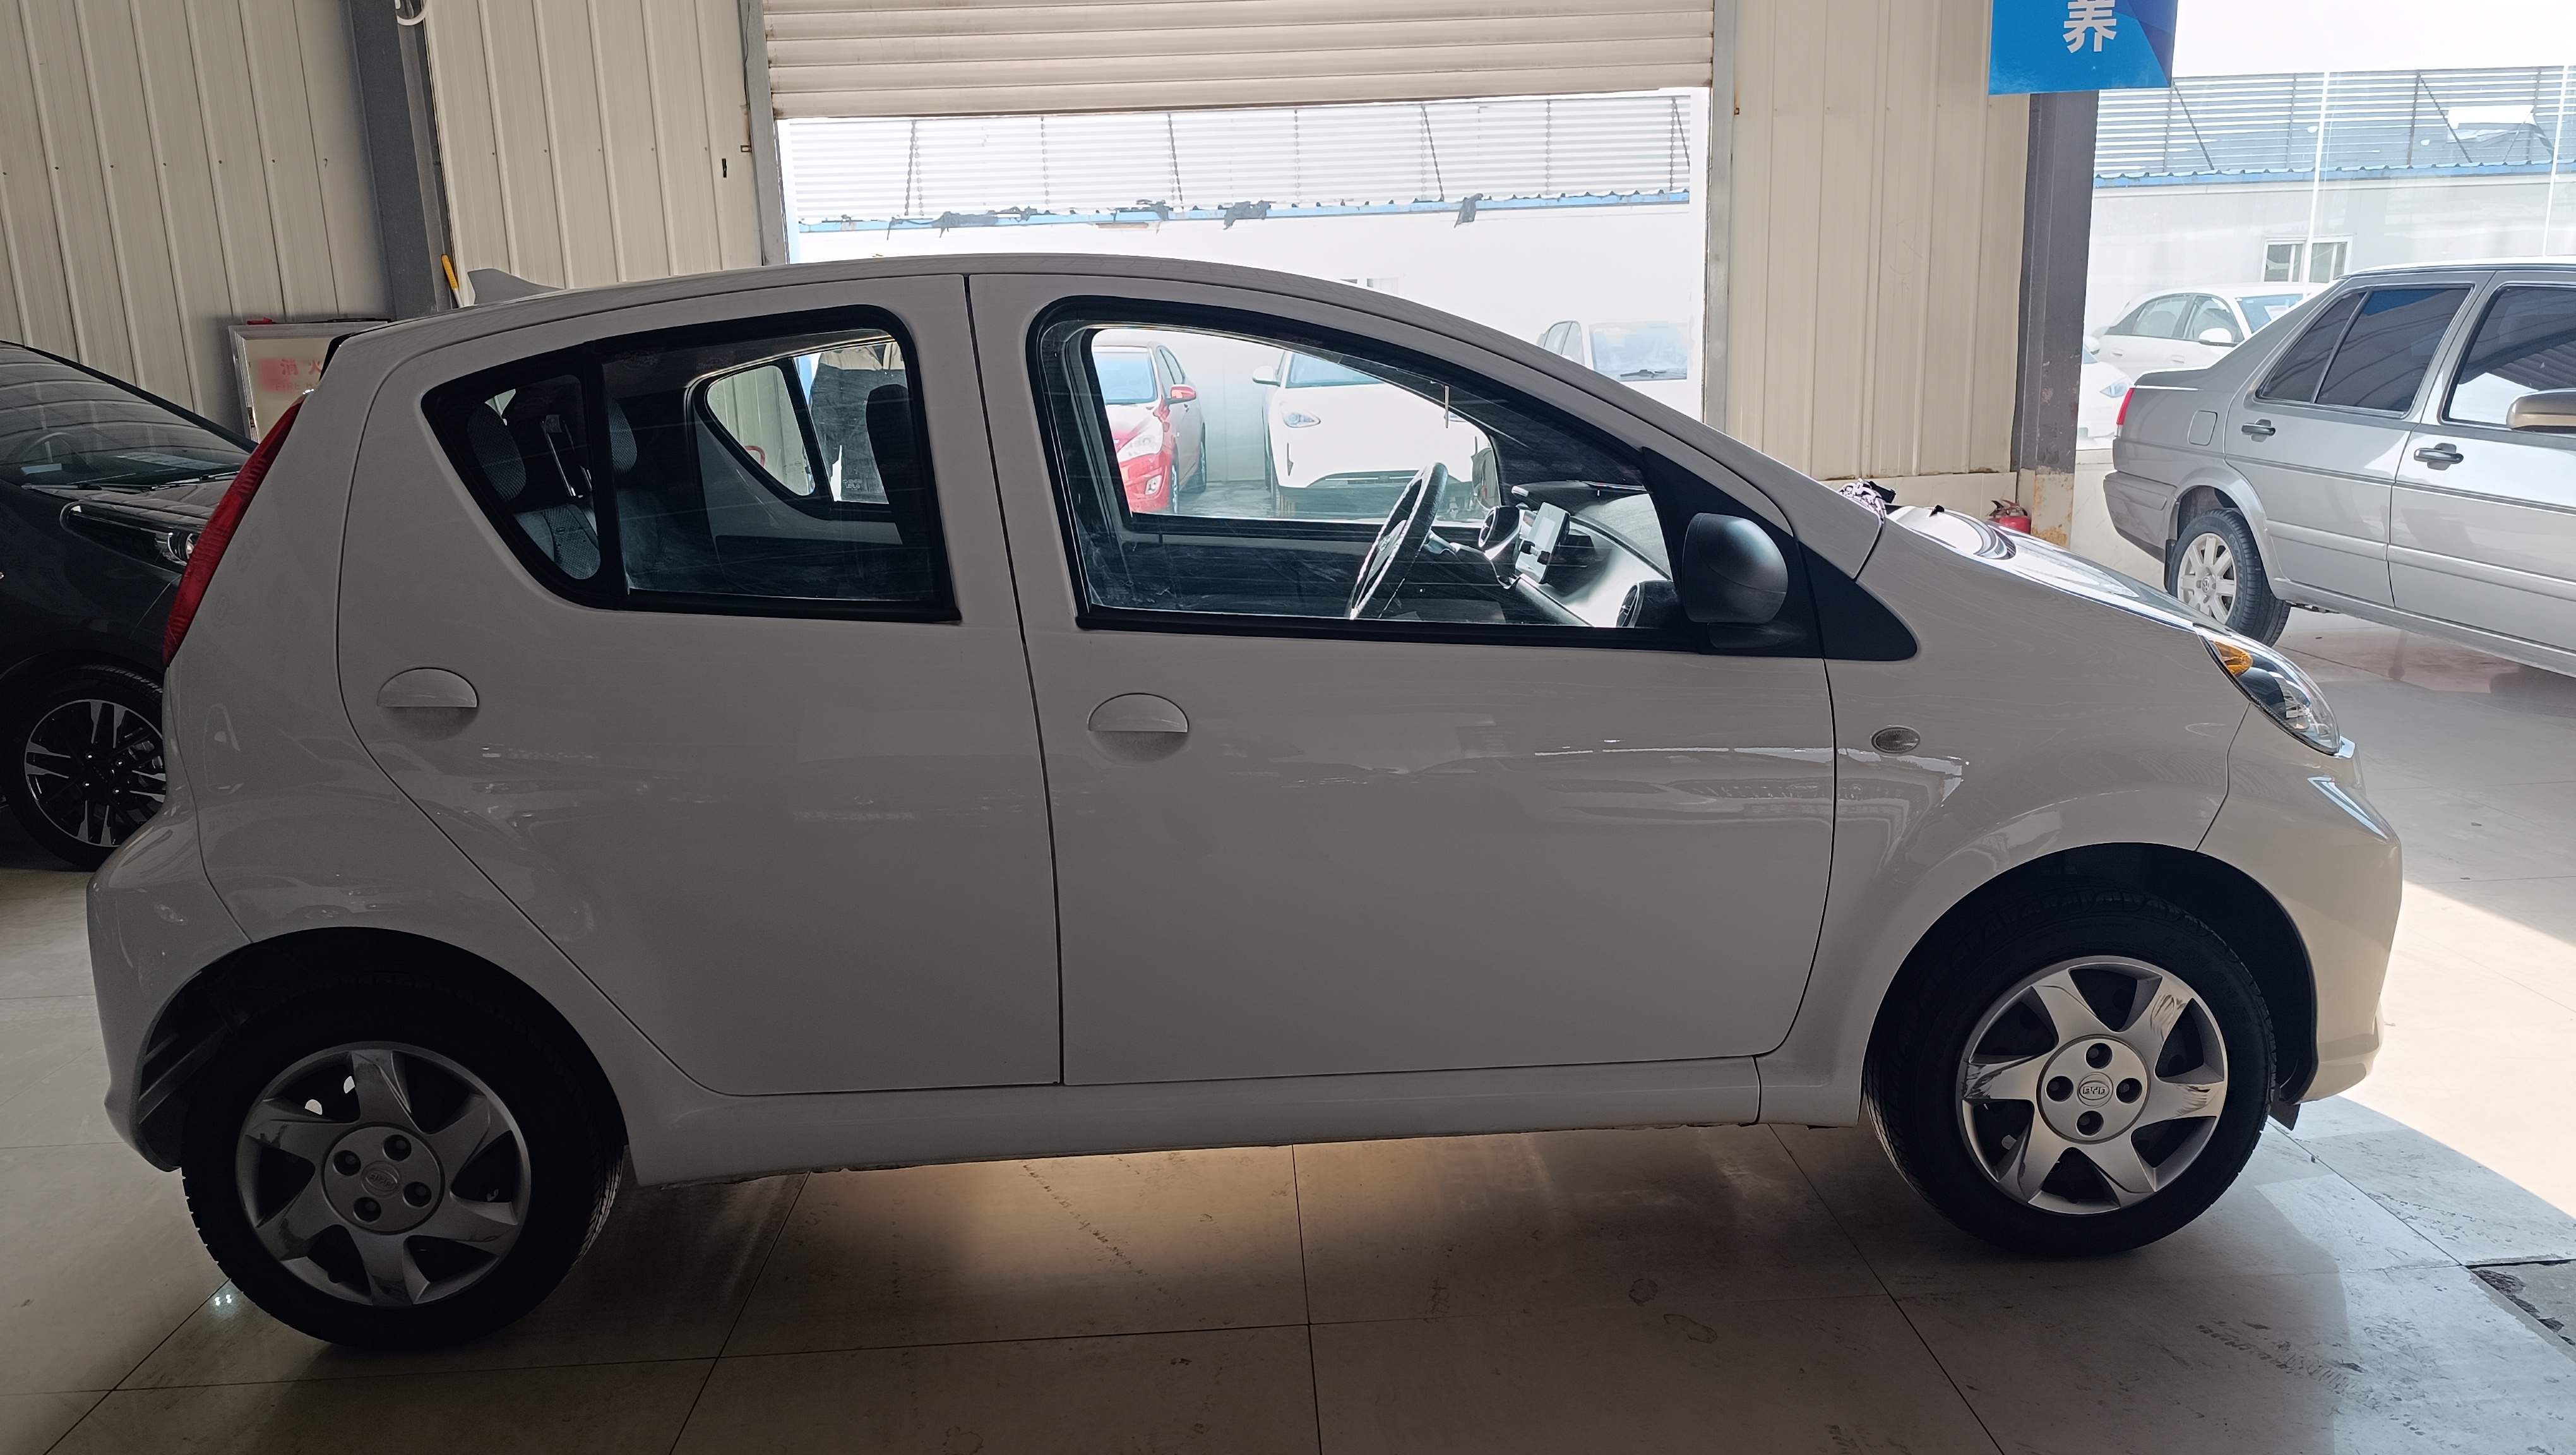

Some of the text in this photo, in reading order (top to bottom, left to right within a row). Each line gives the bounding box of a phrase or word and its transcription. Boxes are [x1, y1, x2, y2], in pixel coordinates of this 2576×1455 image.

[2062, 0, 2117, 53] 养
[275, 381, 301, 391] FIRE
[2082, 1086, 2107, 1095] BYD
